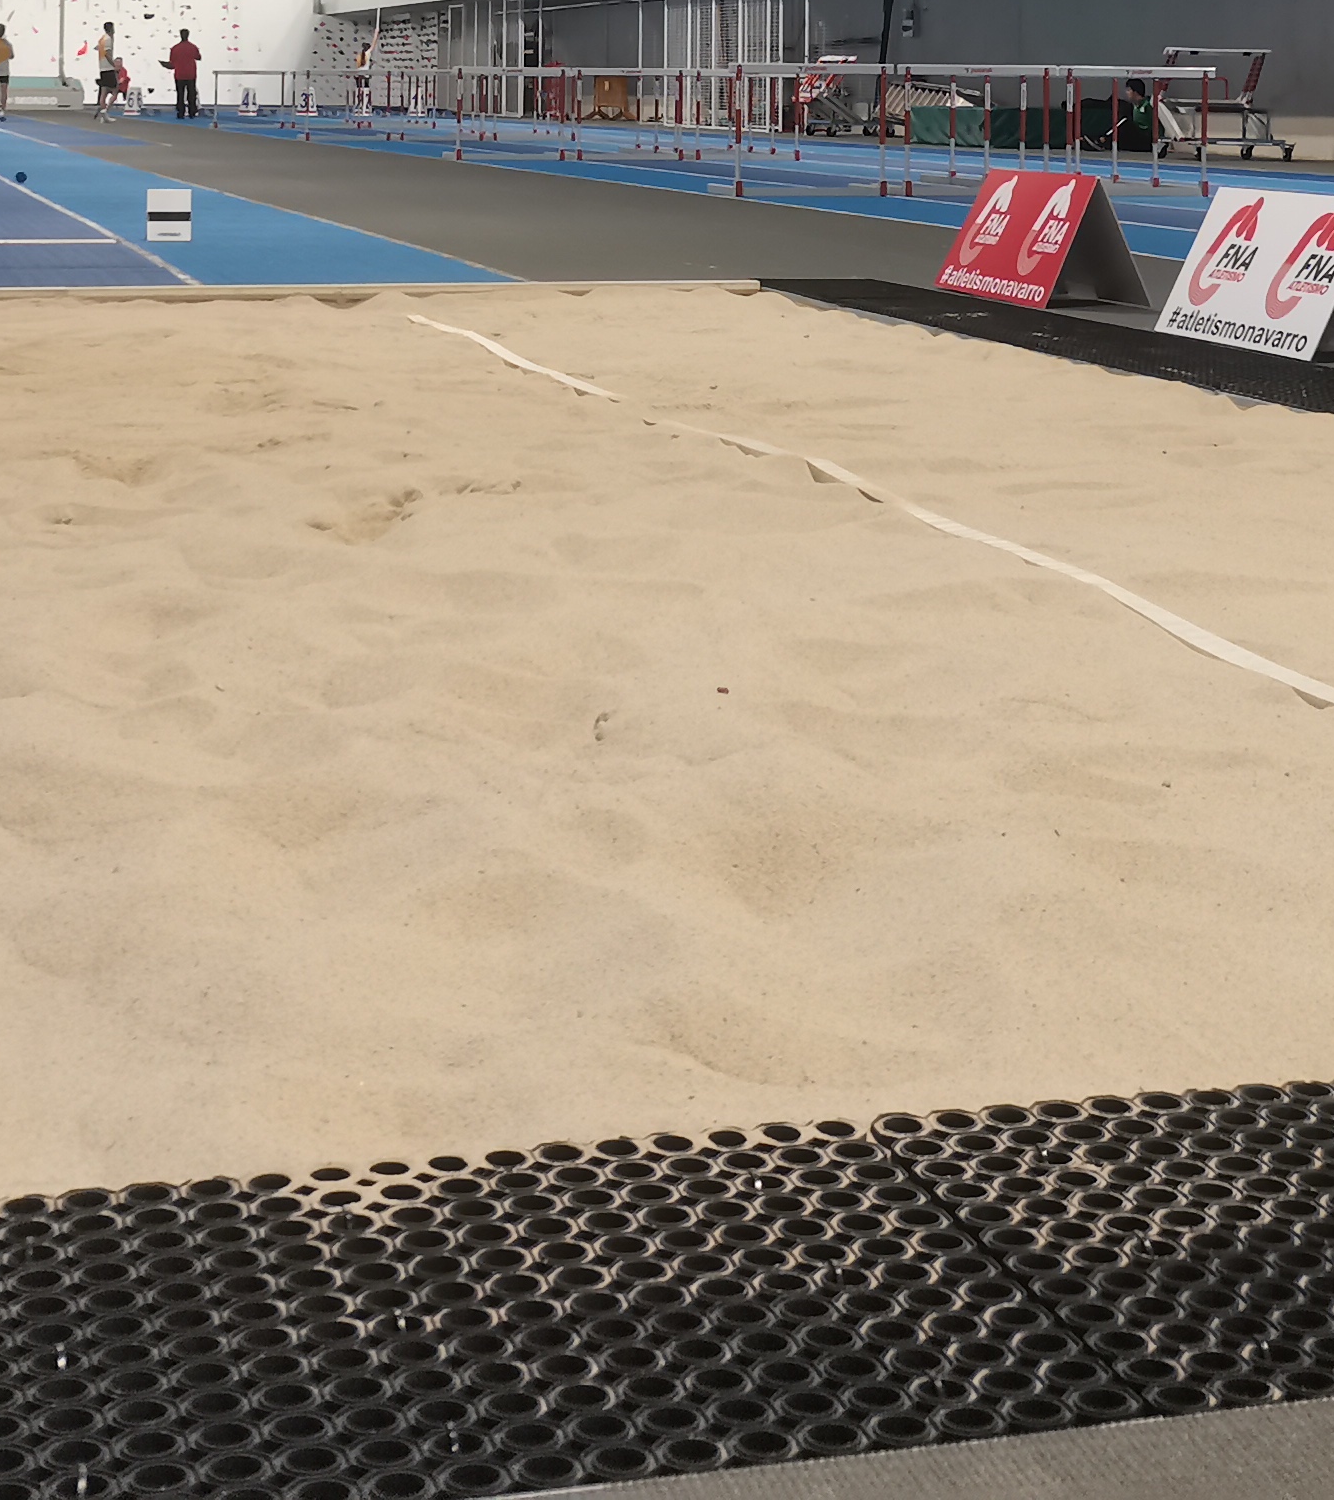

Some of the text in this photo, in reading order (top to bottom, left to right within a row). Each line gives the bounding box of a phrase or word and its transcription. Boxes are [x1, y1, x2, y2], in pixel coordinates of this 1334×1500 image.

[980, 213, 1011, 236] FNA
[1038, 219, 1070, 245] FNA
[1216, 243, 1259, 271] FNA
[939, 265, 1045, 302] #atletismonavarro
[1167, 306, 1308, 353] #atletismonavarro
